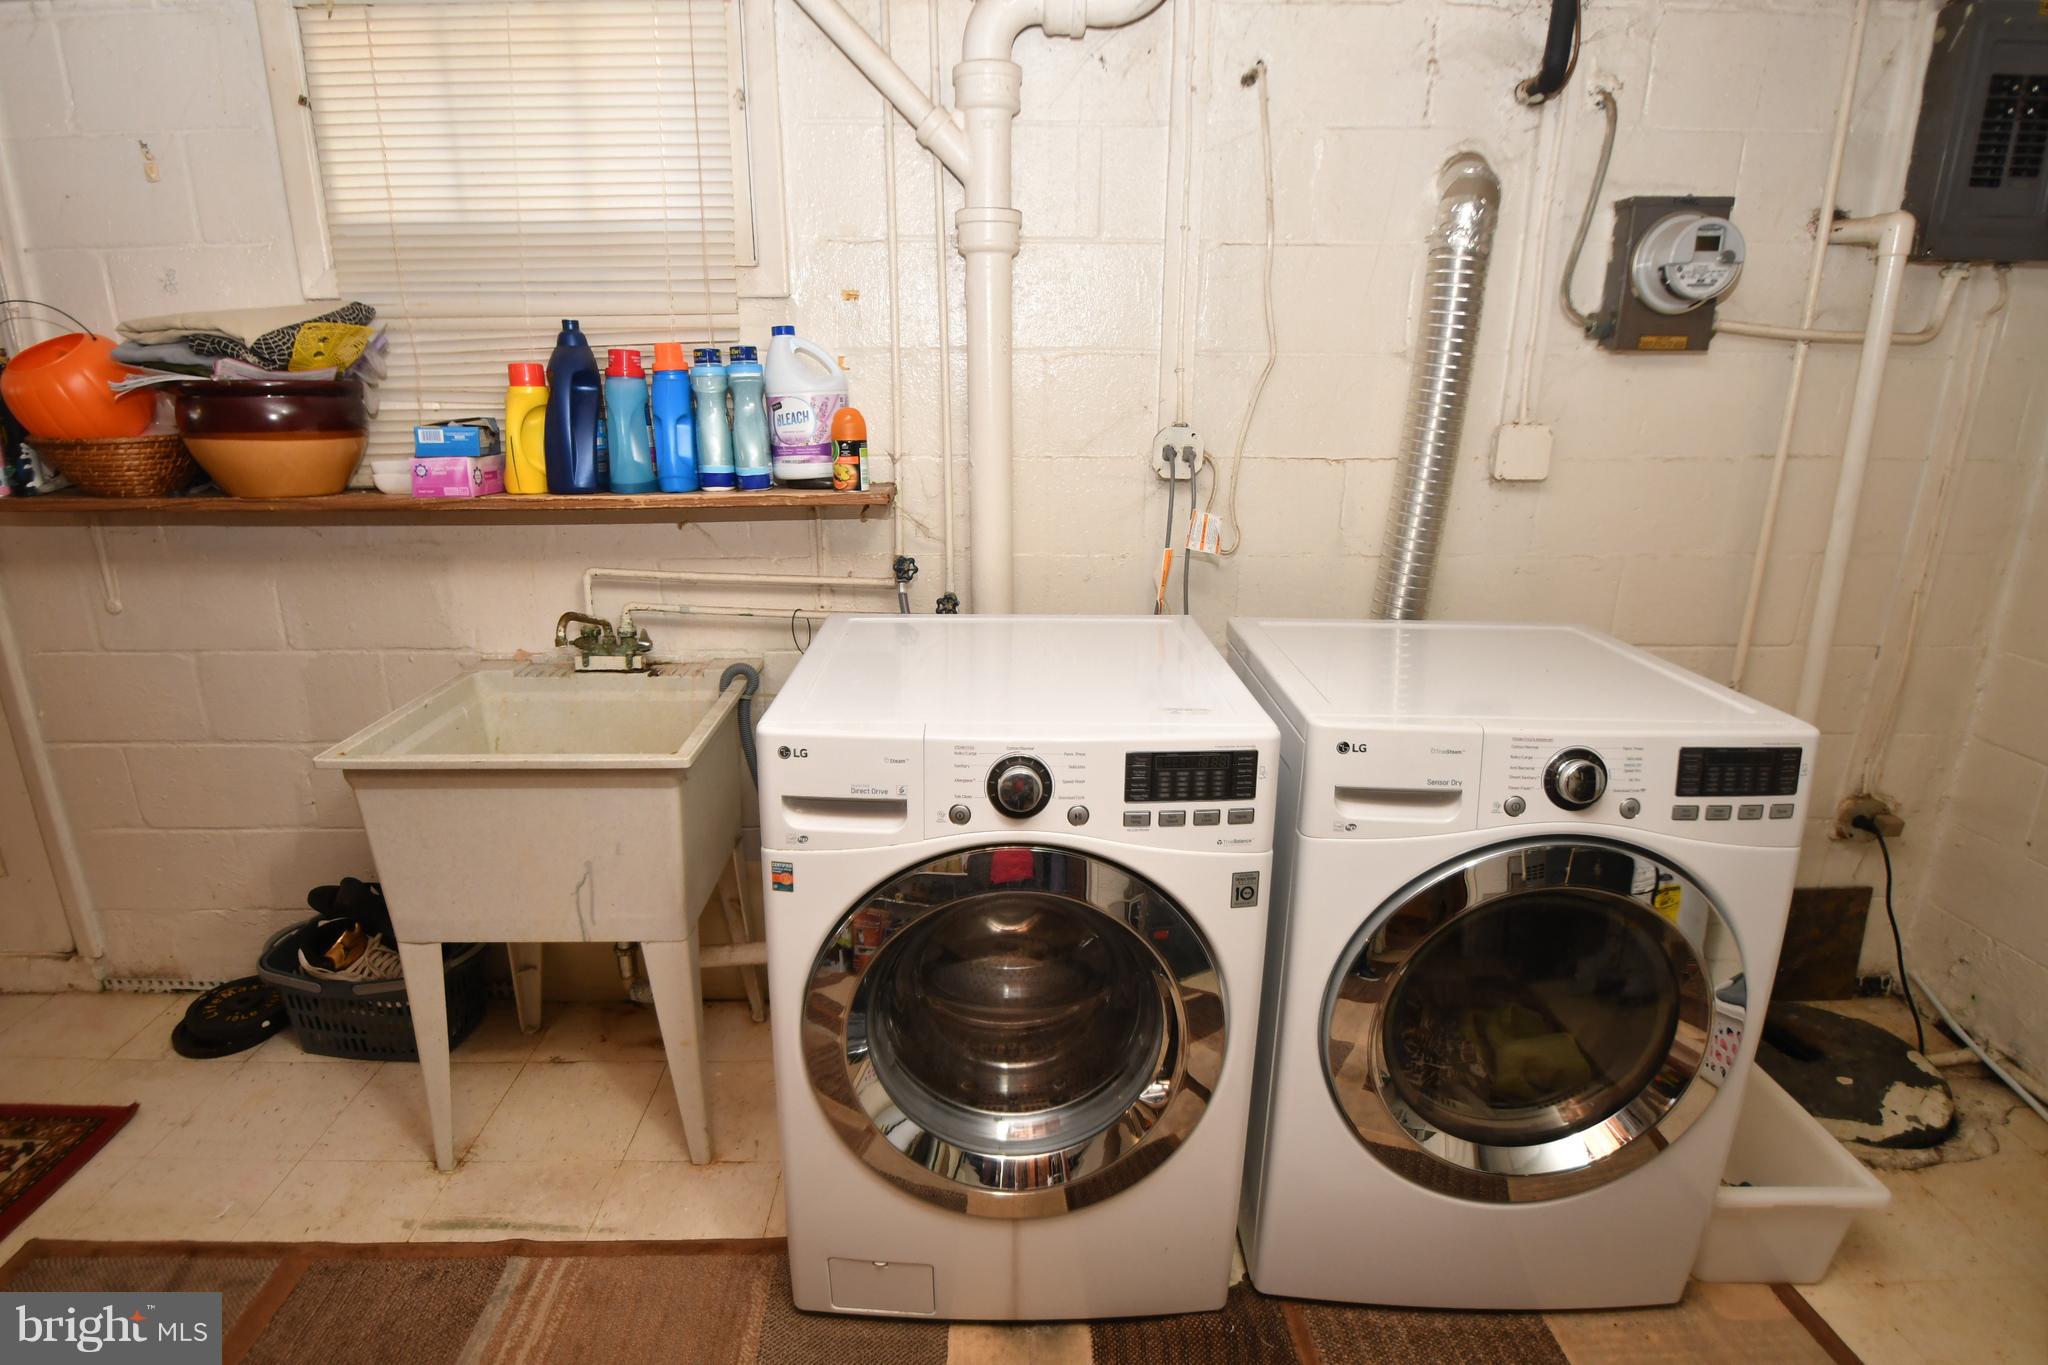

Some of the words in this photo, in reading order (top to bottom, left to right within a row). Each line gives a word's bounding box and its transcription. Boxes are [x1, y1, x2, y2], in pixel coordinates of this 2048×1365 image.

[777, 410, 809, 427] BLEACH
[794, 748, 808, 758] LG
[1352, 744, 1367, 753] LG
